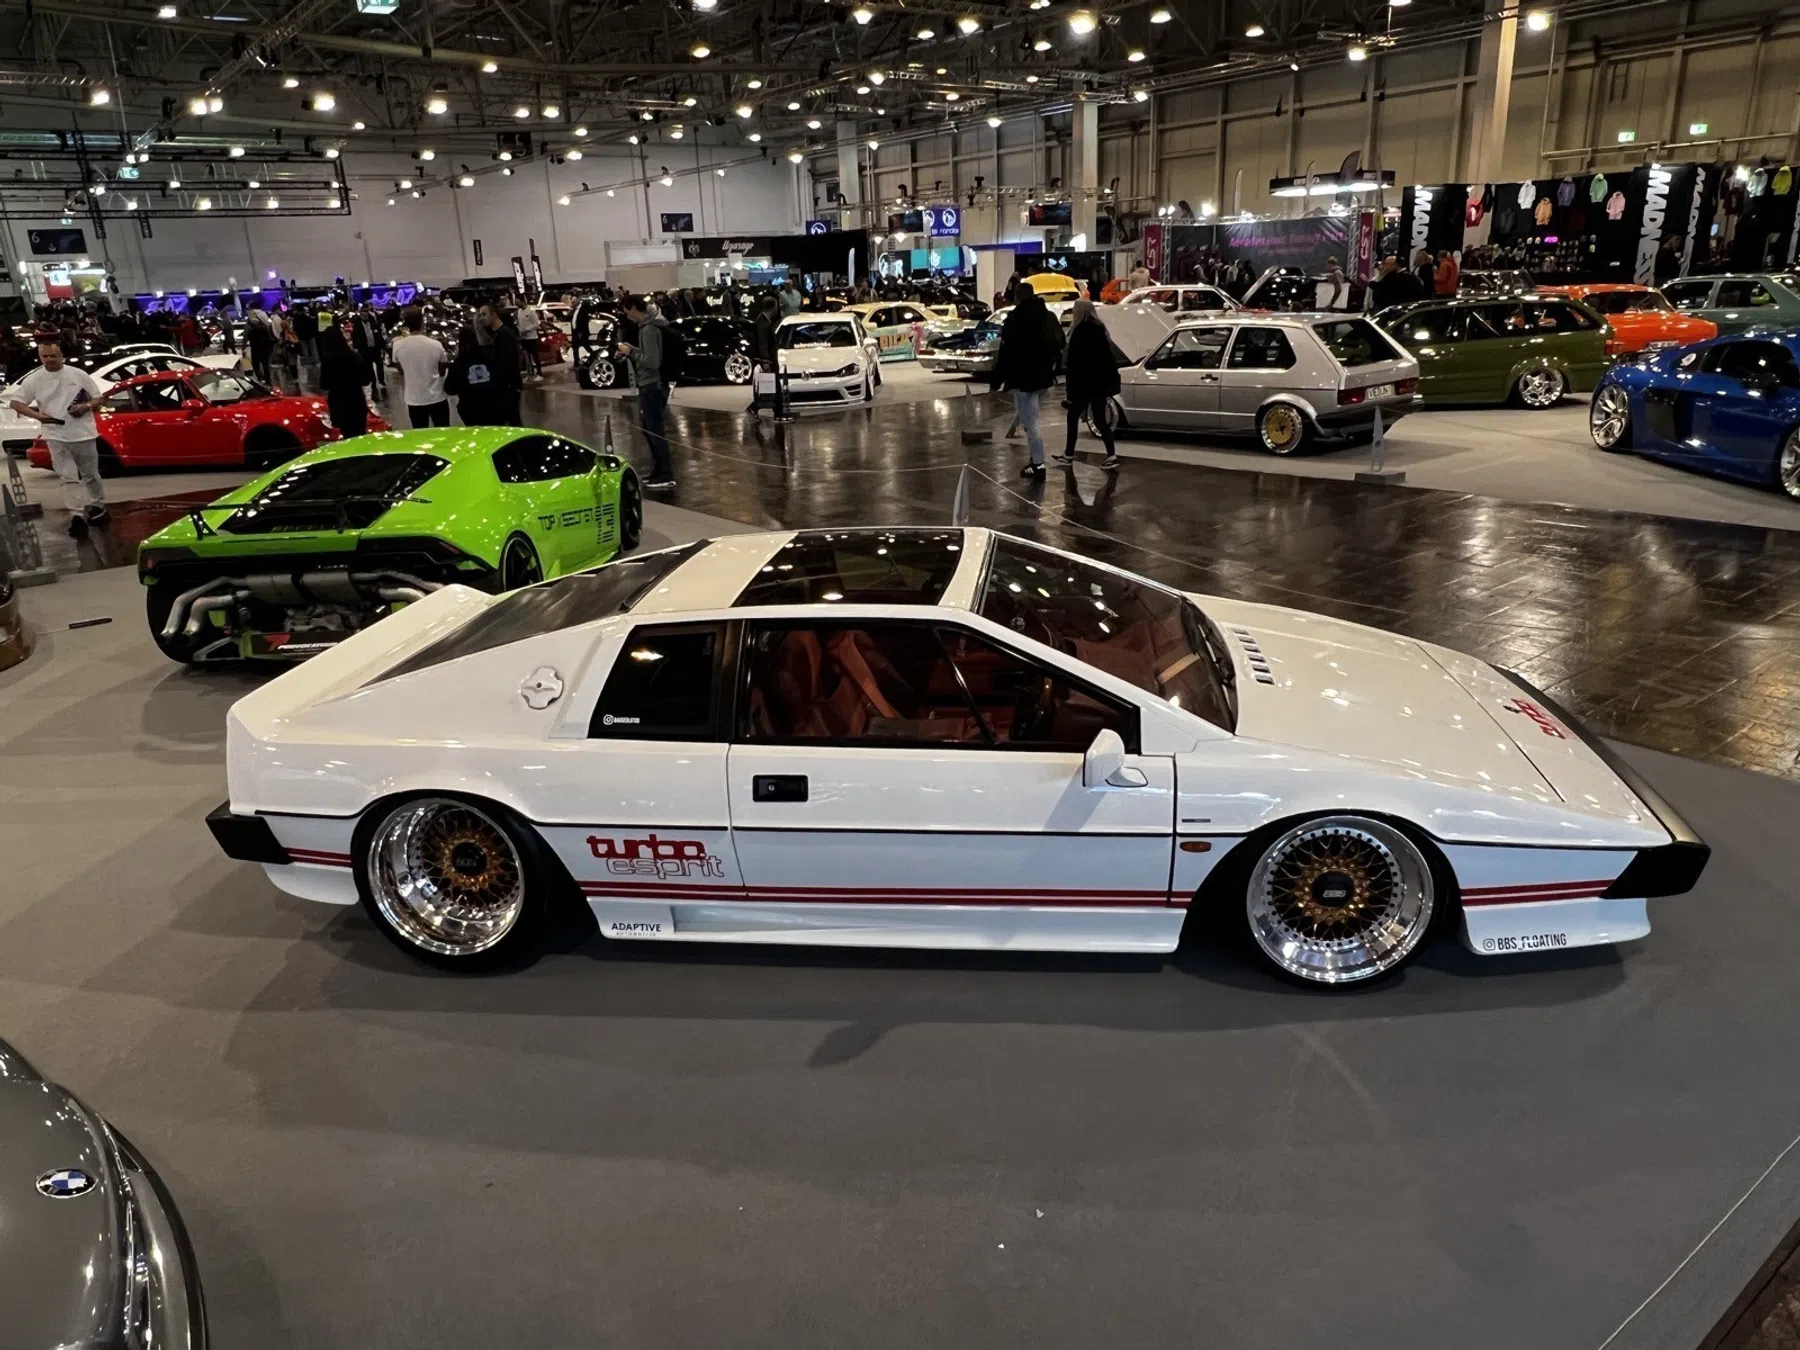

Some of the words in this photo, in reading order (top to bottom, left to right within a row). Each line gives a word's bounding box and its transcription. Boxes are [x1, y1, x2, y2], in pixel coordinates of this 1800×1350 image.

[31, 232, 40, 243] 6
[586, 834, 706, 860] turbo
[606, 855, 725, 879] esprit
[611, 922, 661, 932] ADAPTIVE
[1497, 932, 1567, 951] BBS_FLOATING
